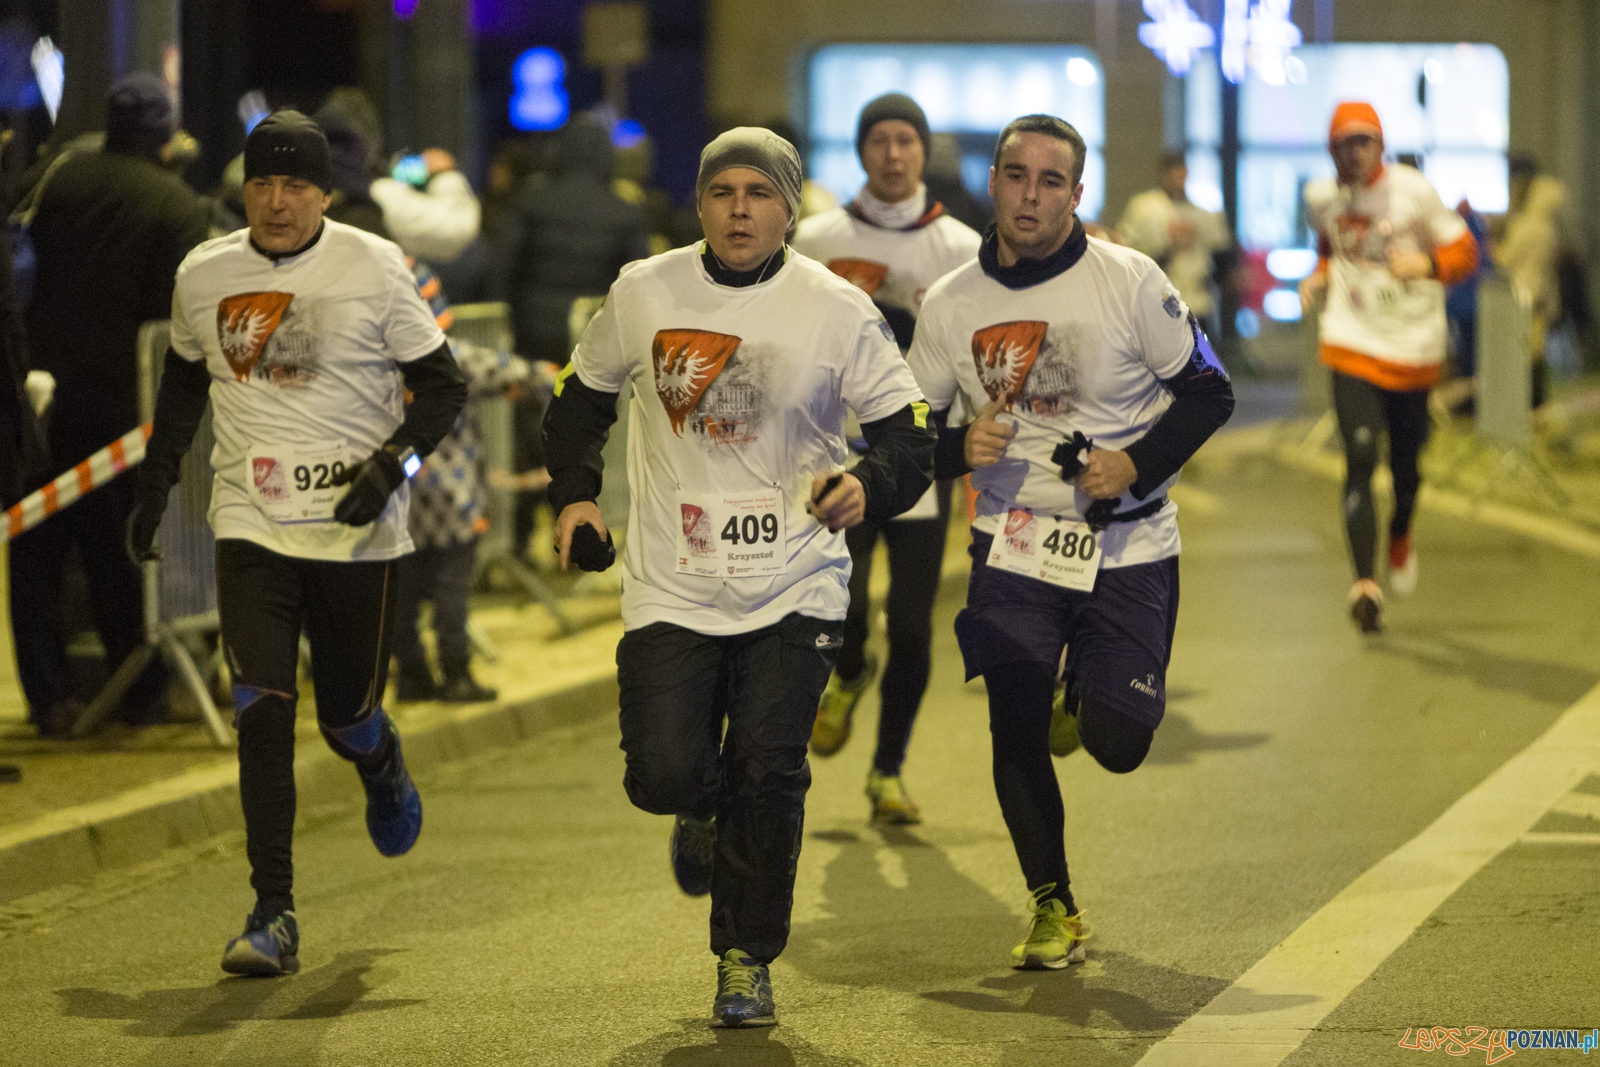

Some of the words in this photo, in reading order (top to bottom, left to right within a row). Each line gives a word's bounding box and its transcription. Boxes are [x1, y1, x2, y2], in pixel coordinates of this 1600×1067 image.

[721, 513, 778, 545] 409
[727, 551, 774, 561] Krzysztof
[1042, 529, 1096, 561] 480
[1042, 559, 1085, 575] Krzysztof
